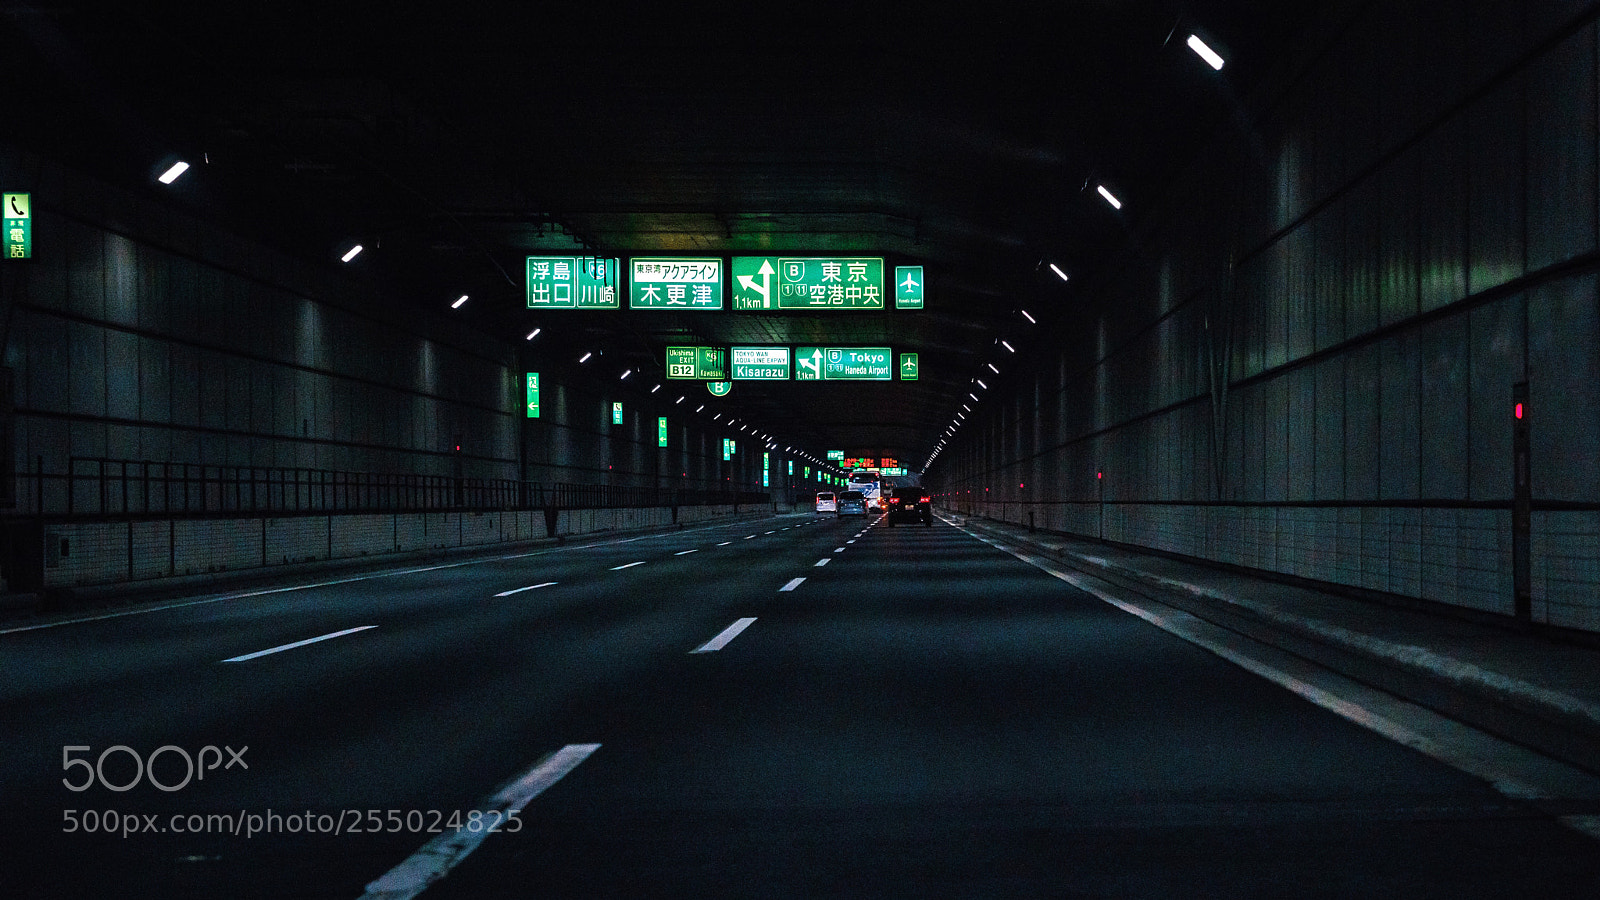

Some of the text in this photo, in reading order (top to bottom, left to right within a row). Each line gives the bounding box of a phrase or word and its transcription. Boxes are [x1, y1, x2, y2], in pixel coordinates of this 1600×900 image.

[532, 261, 571, 281] 浮島
[636, 264, 716, 280] 東京湾 アクアライン
[789, 265, 799, 277] B
[821, 262, 868, 283] 東京
[532, 283, 571, 304] 出口
[581, 285, 615, 304] 川崎
[640, 284, 712, 305] 木更津
[797, 286, 806, 294] 11
[809, 284, 880, 305] 空港中央
[831, 352, 838, 360] B
[849, 352, 884, 364] Tokyo
[672, 366, 692, 375] B12
[737, 366, 784, 377] Kisarazu
[845, 365, 889, 376] Haneda Airport
[715, 382, 724, 393] B
